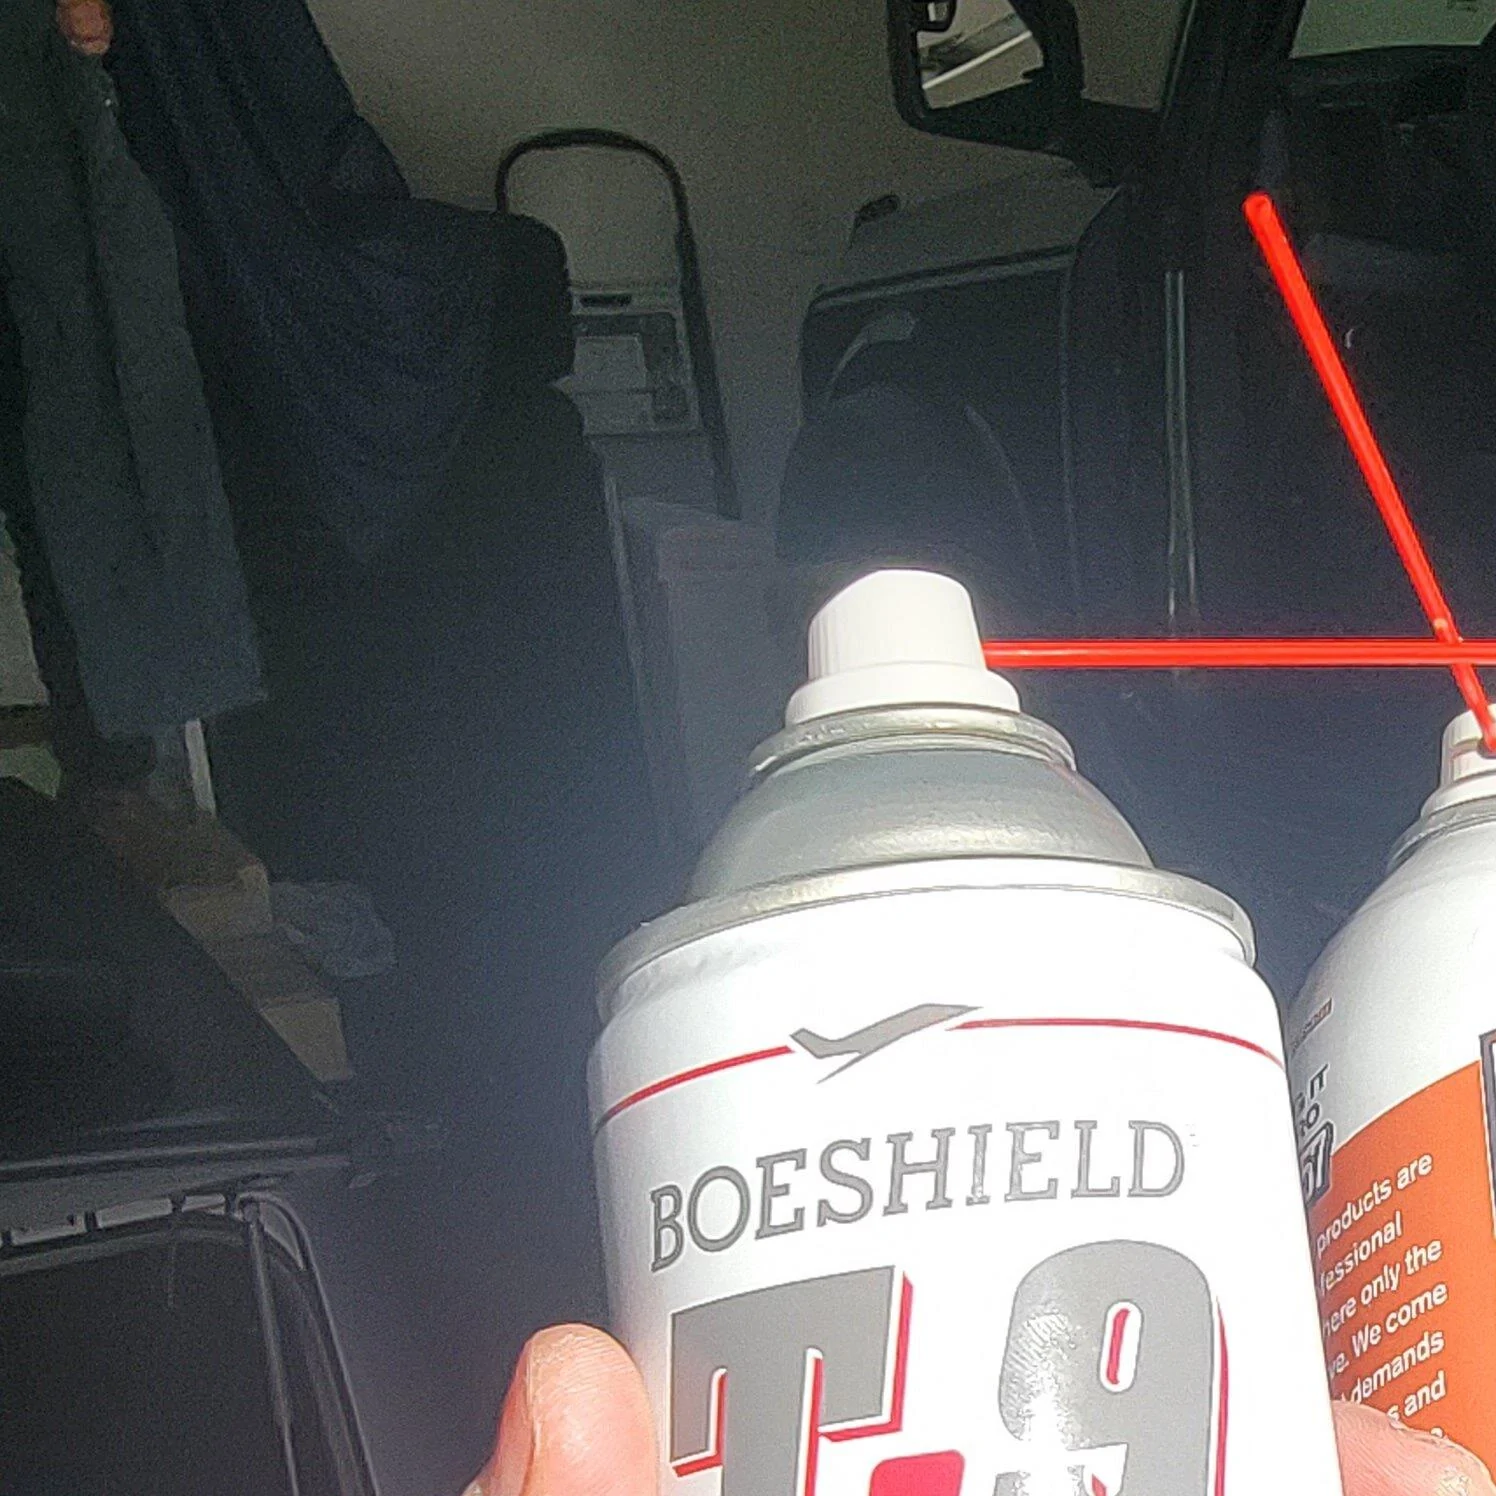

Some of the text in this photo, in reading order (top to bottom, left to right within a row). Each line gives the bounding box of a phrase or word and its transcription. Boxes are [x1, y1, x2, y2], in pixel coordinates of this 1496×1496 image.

[650, 1120, 1185, 1272] BOESHIELD
[1397, 1153, 1433, 1191] are
[1361, 1263, 1401, 1306] only
[1404, 1240, 1443, 1276] the
[1352, 1323, 1382, 1358] We
[1385, 1282, 1448, 1335] come
[1350, 1330, 1445, 1405] demands
[1403, 1370, 1447, 1418] and
